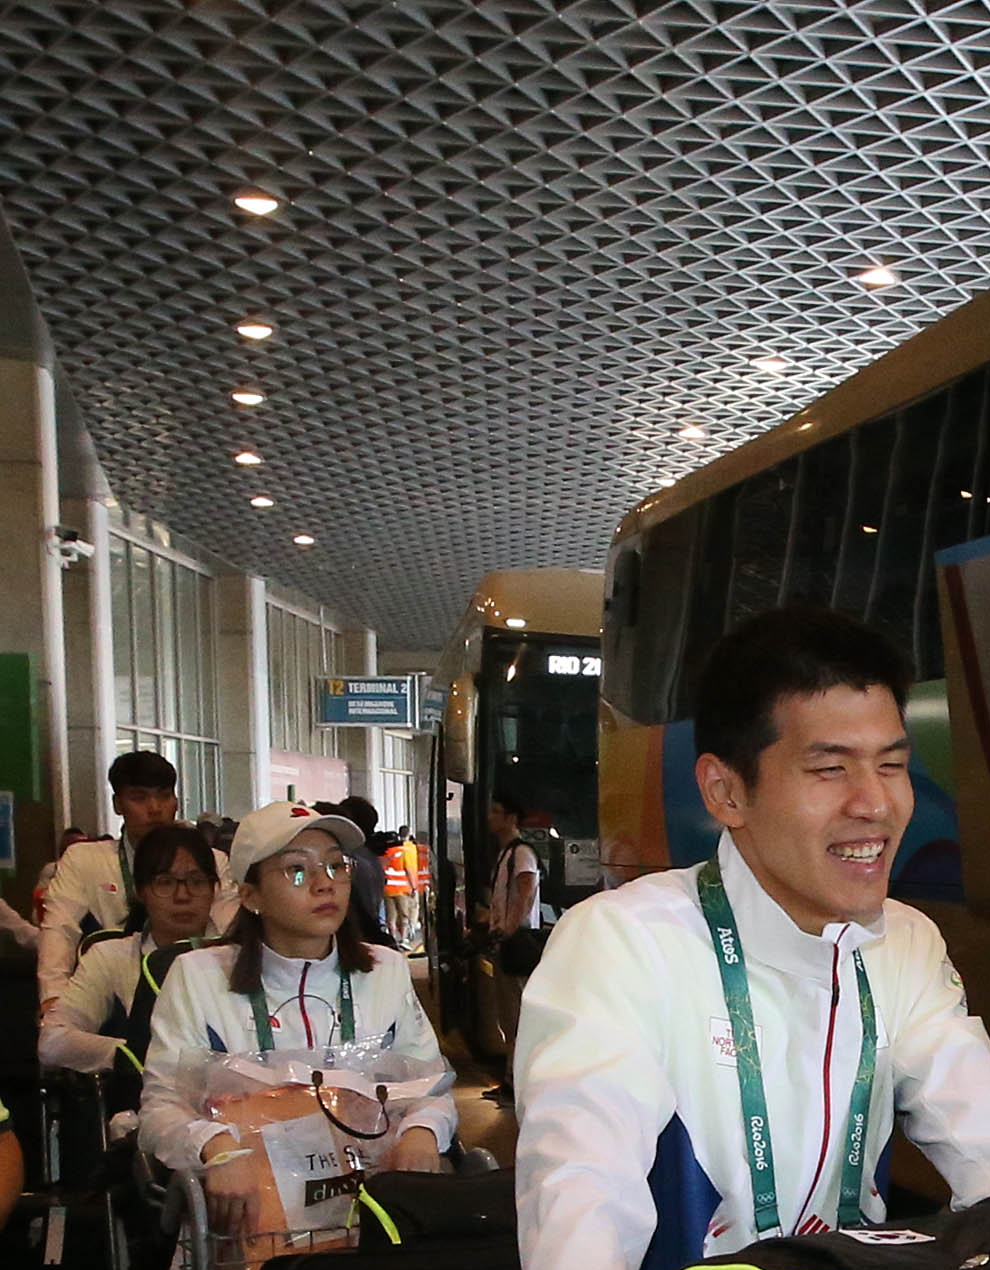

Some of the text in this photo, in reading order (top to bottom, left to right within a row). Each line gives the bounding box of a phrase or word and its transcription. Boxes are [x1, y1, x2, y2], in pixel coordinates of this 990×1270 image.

[328, 681, 408, 696] T2 TERMINAL 2
[717, 926, 739, 966] Atos
[712, 1036, 736, 1048] NORT
[719, 1046, 738, 1058] FAC
[305, 1152, 338, 1171] THE
